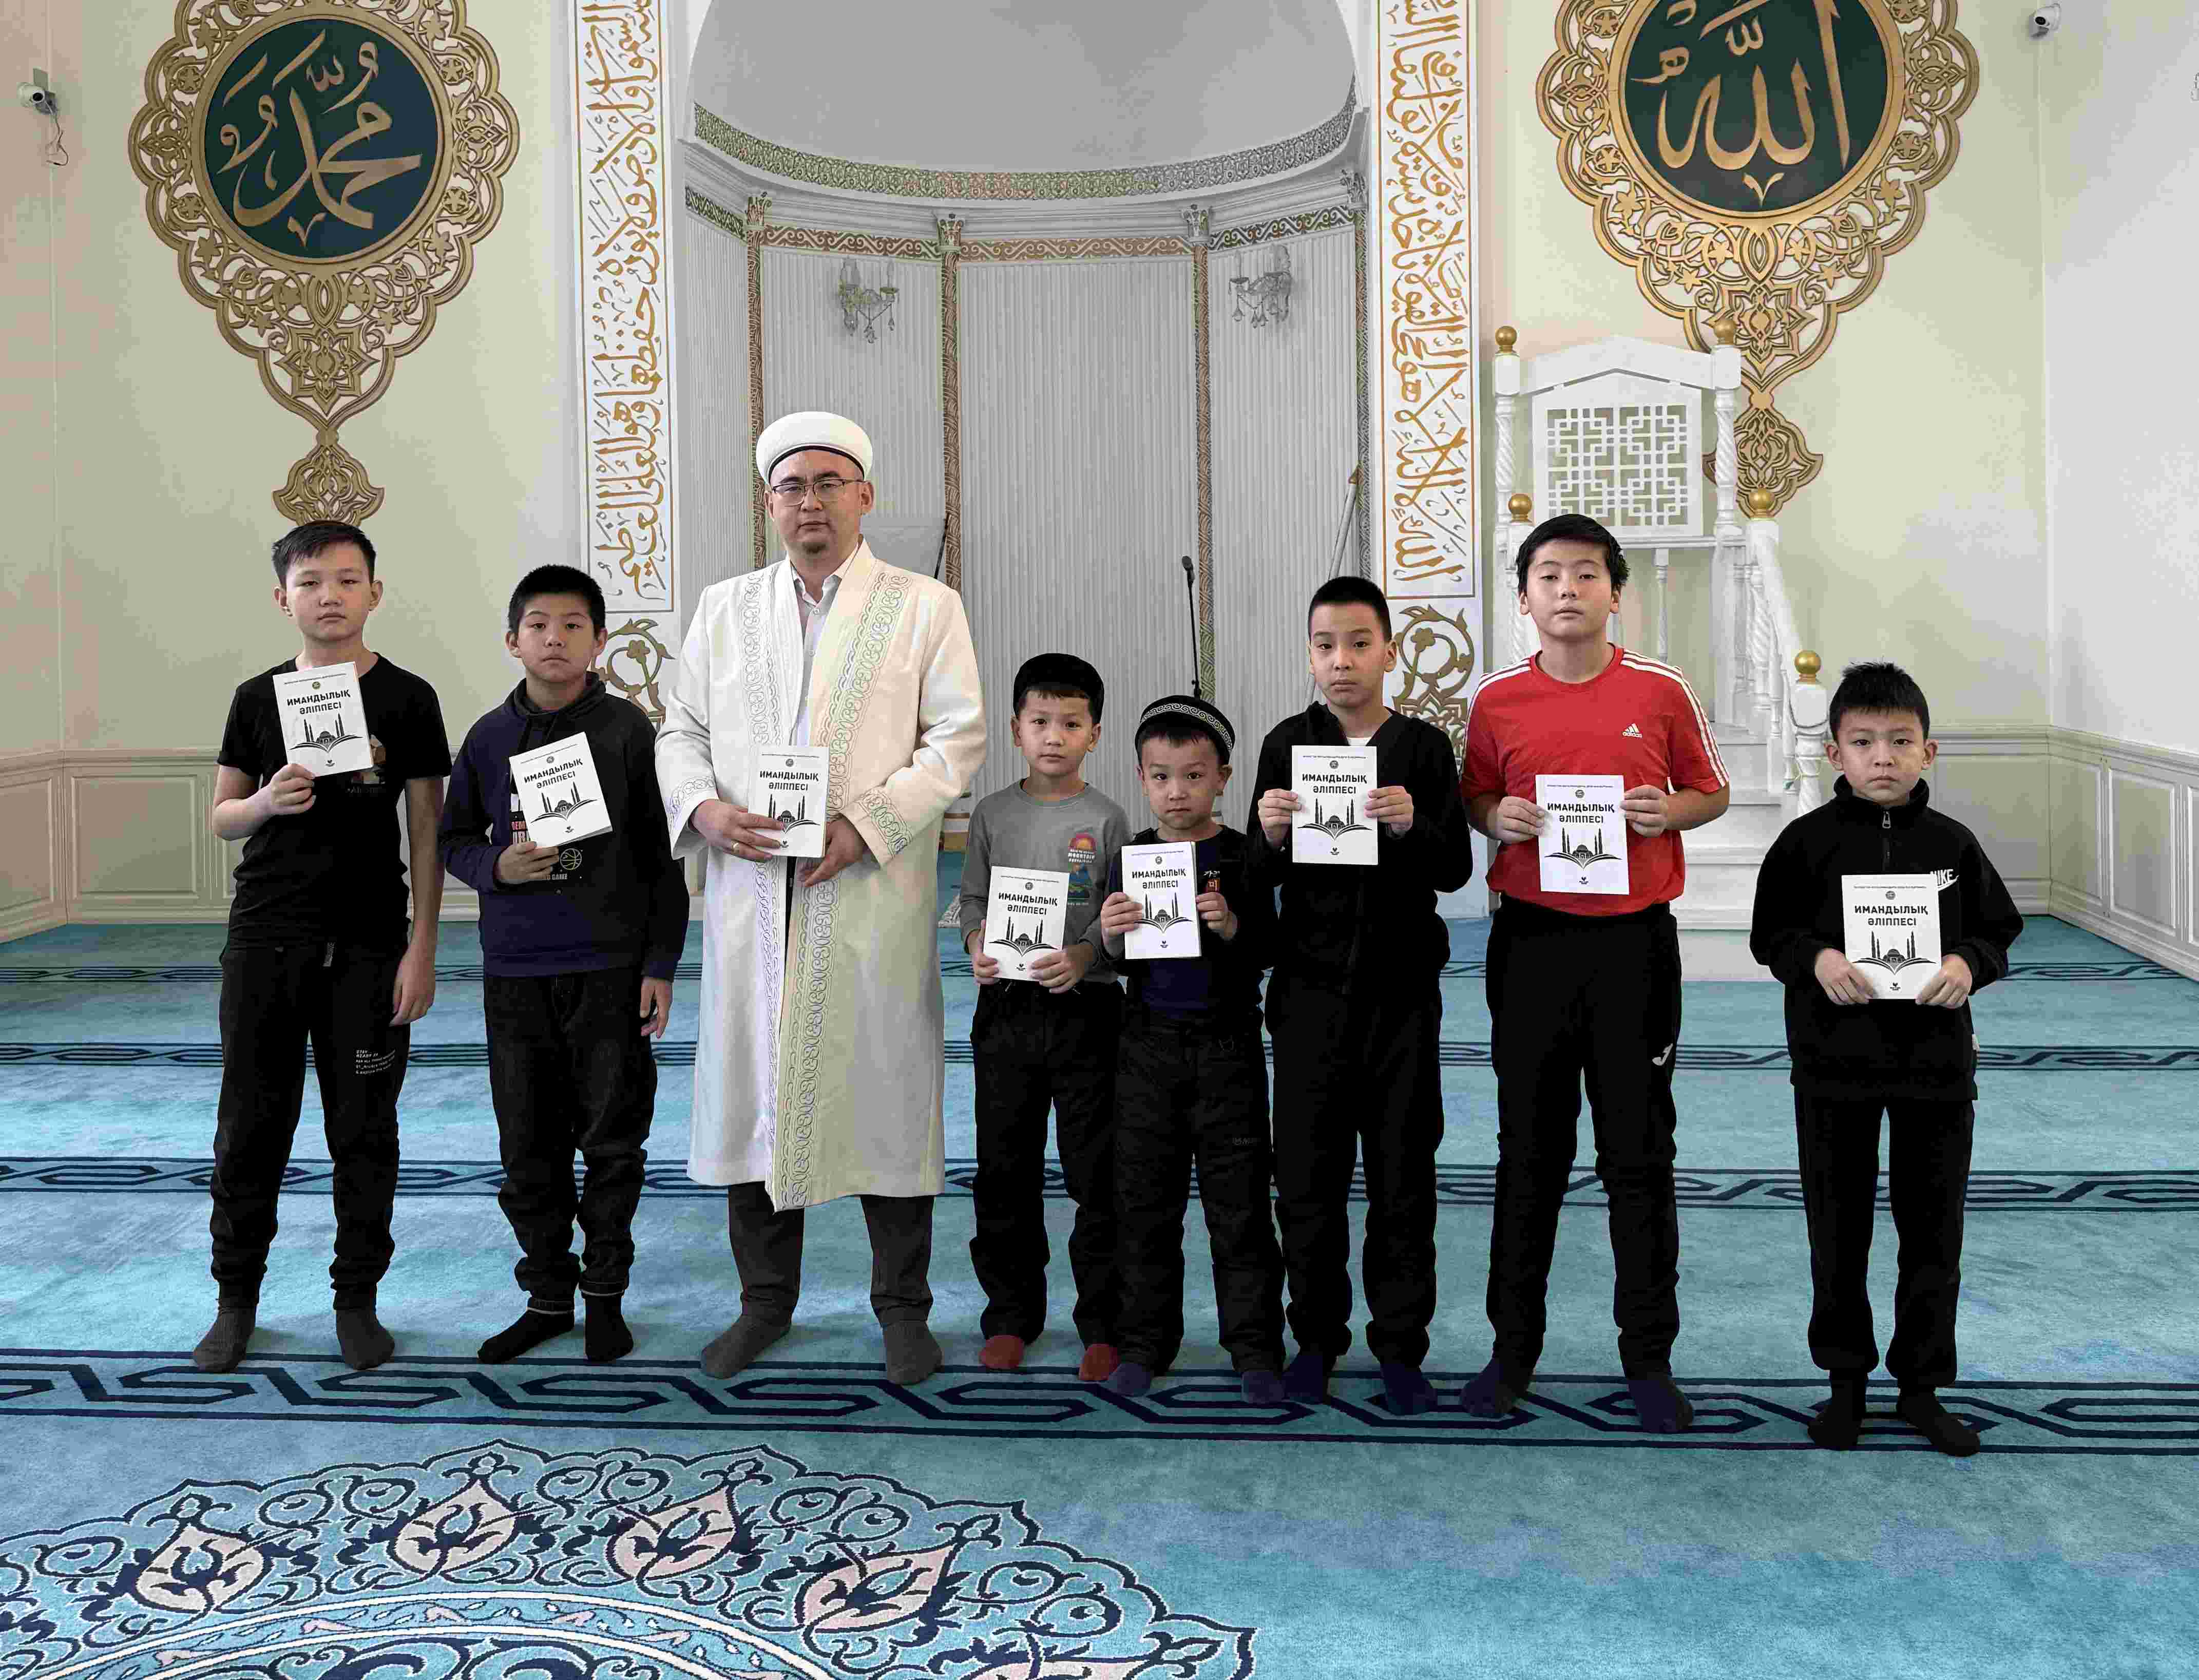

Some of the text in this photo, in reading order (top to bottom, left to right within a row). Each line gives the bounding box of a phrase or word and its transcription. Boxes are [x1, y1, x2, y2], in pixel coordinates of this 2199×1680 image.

[287, 690, 350, 707] ИМАНДЫЛЫҚ
[299, 702, 341, 714] ӘЛІППЕСІ
[524, 758, 583, 783] ИМАНДЫЛЫҚ
[537, 771, 576, 789] ӘЛІППЕСІ
[760, 771, 819, 781] ИМАНДЫЛЫҚ
[1303, 774, 1367, 784] ИМАНДЫЛЫҚ
[769, 782, 808, 791] ӘЛІППЕСІ
[1547, 803, 1614, 813] ИМАНДЫЛЫҚ
[1132, 869, 1186, 878] ИМАНДЫЛЫҚ
[1142, 880, 1178, 889] ӘЛІППЕСІ
[999, 892, 1057, 906] ИМАНДЫЛЫҚ
[1007, 905, 1046, 914] ӘЛІППЕСІ
[1855, 906, 1928, 915] ИМАНДЫЛЫҚ
